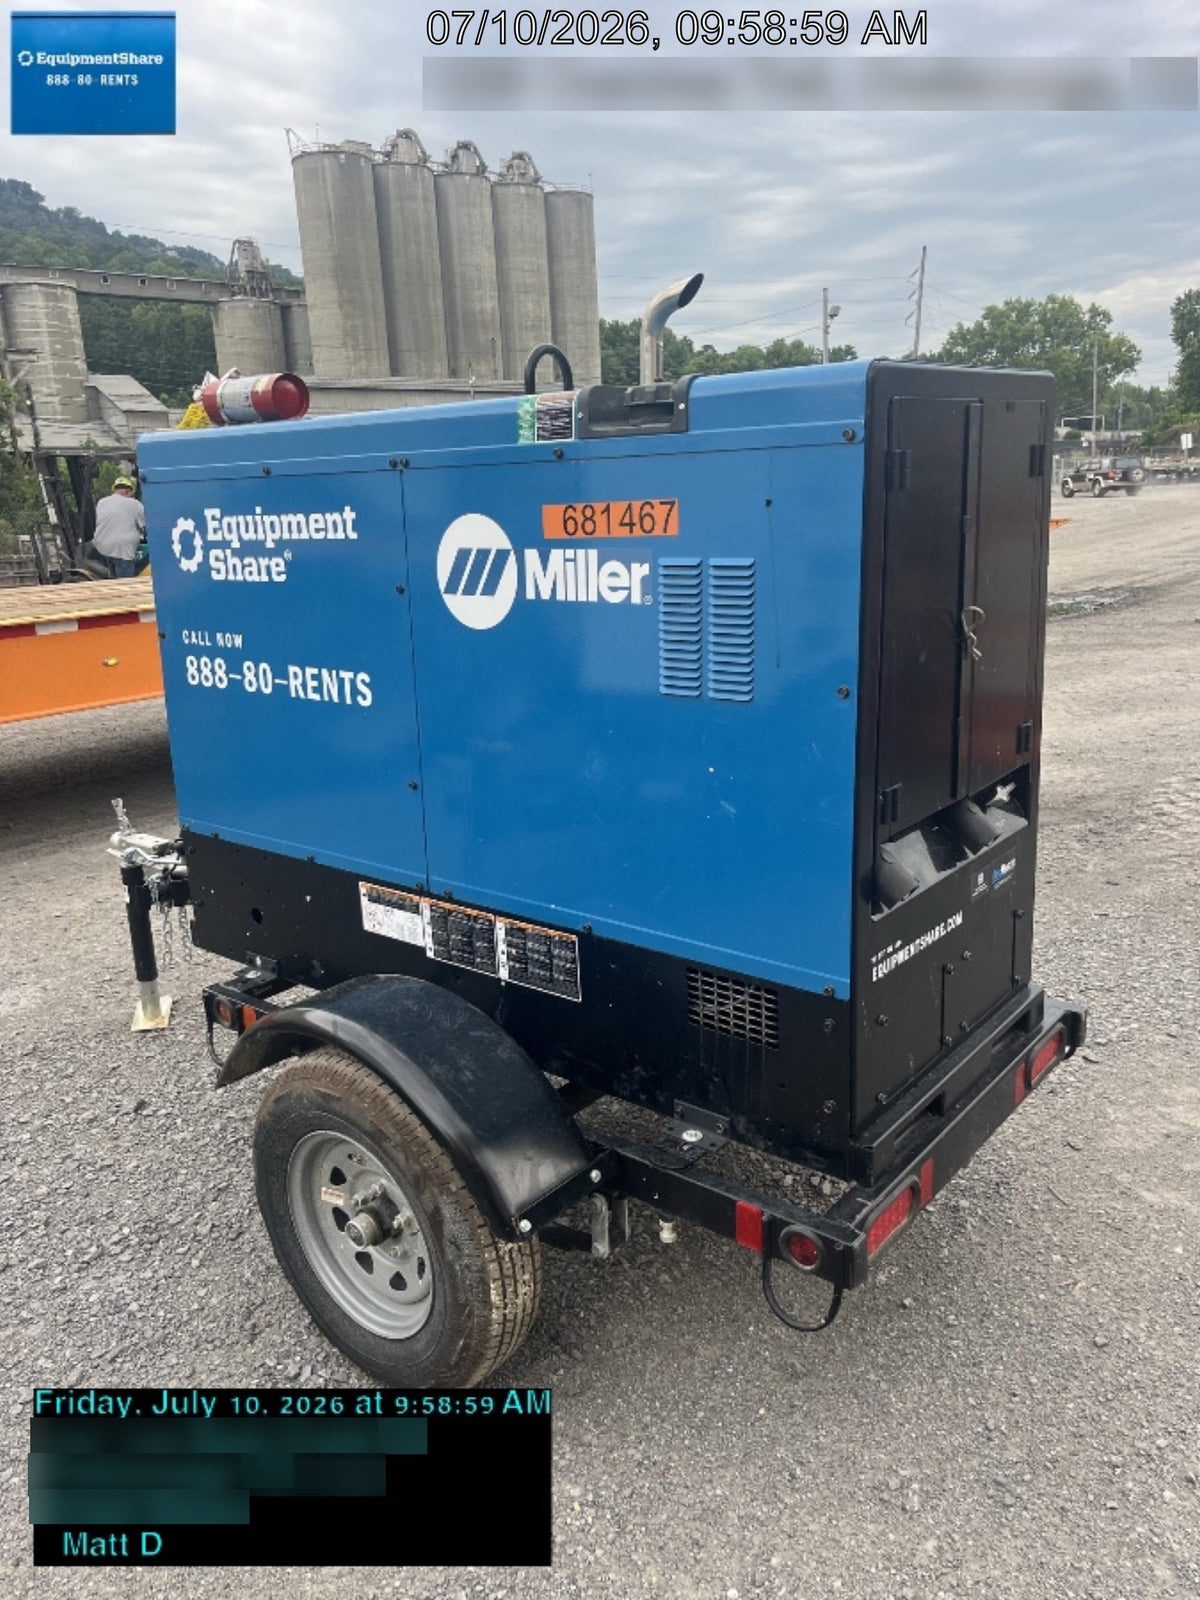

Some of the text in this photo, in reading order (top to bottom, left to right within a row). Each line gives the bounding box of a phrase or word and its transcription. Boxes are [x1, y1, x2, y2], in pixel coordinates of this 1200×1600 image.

[204, 505, 358, 548] Equipment
[562, 500, 677, 536] 681467
[182, 629, 243, 649] CALL NOW
[185, 655, 373, 707] 888-80-RENTS
